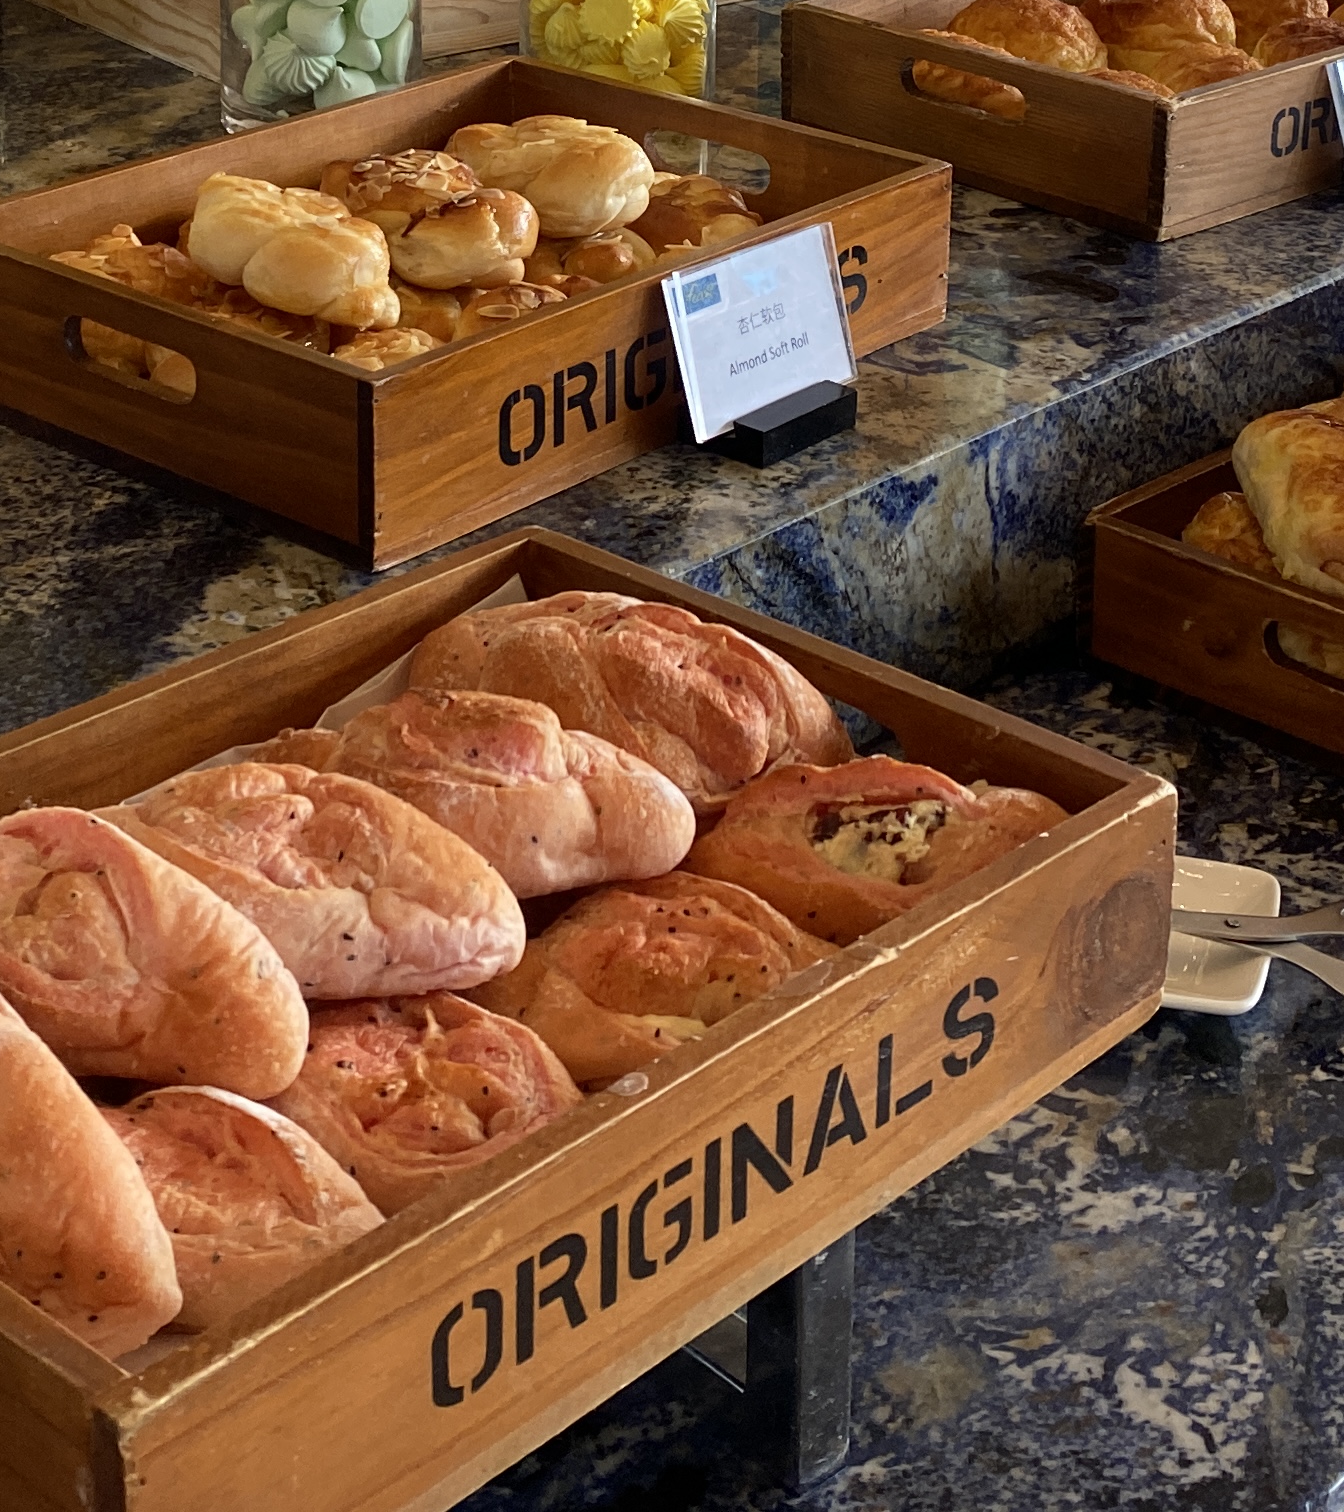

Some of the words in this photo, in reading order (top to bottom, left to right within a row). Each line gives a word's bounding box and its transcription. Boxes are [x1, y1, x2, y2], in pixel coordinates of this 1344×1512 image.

[737, 302, 786, 336] 杏仁软包
[729, 351, 768, 377] Almond
[769, 342, 790, 360] Soft
[791, 331, 809, 351] Roll
[430, 976, 999, 1408] ORIGINALS
